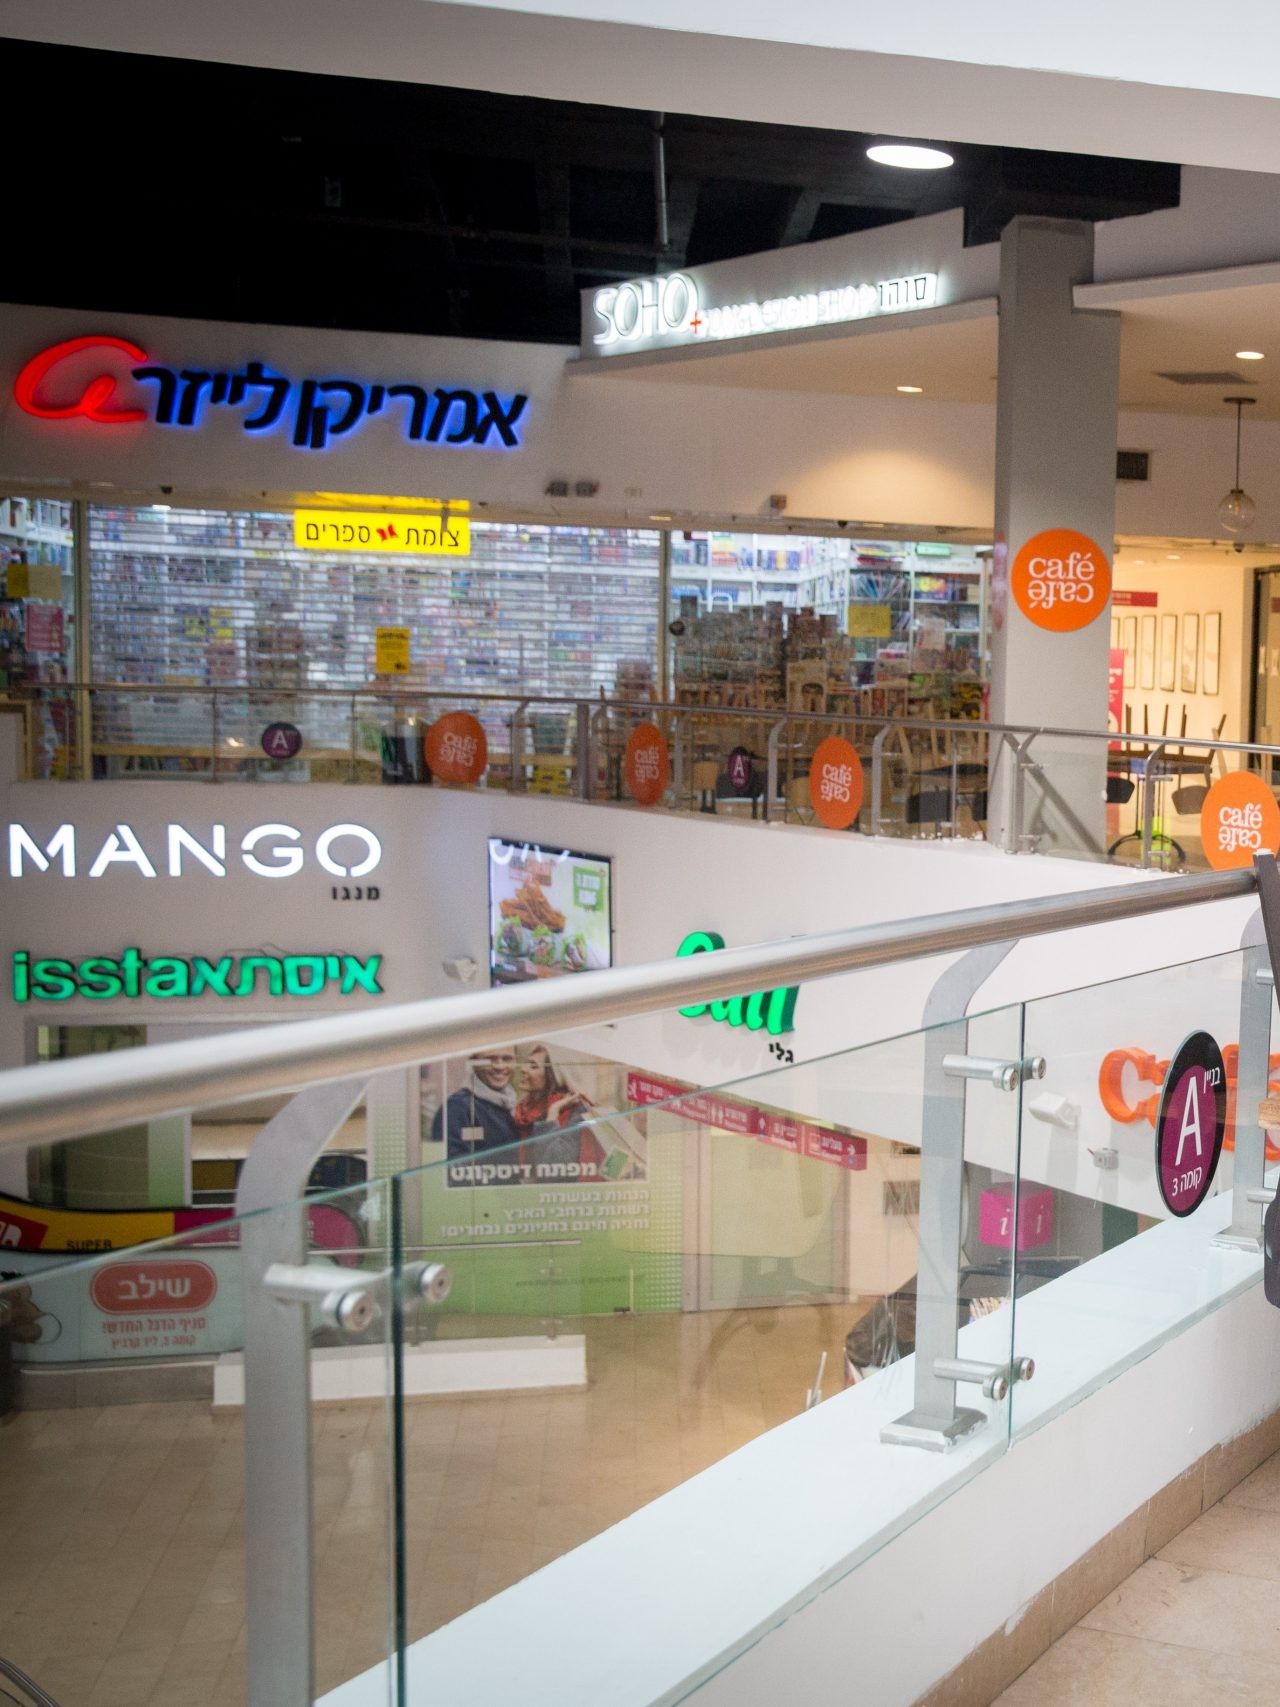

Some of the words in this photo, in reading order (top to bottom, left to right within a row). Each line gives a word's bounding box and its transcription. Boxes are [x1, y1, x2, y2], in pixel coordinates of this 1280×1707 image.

[594, 272, 698, 346] SOHO
[132, 362, 291, 428] לייזר
[293, 379, 528, 449] אמריקן
[305, 523, 371, 544] ספרים
[405, 528, 460, 547] צומת
[1028, 552, 1096, 580] café
[733, 755, 745, 777] A
[822, 763, 852, 786] café
[1219, 803, 1263, 829] café
[8, 823, 383, 879] MANGO
[331, 885, 381, 901] מנגו
[13, 947, 192, 1001] issta
[192, 953, 384, 998] איסתא
[768, 1042, 794, 1063] גלי
[1203, 1067, 1221, 1094] בניין
[1175, 1075, 1203, 1167] A
[450, 1163, 533, 1184] דיסקונט
[536, 1162, 599, 1178] מפתח
[1180, 1166, 1203, 1193] קומה
[539, 1191, 600, 1203] בעשרות
[1171, 1178, 1179, 1196] 3
[503, 1207, 546, 1220] הארץ
[549, 1205, 594, 1217] ברחבי
[505, 1222, 569, 1235] בחניונים
[572, 1220, 607, 1231] חינם
[117, 1273, 191, 1300] שילב
